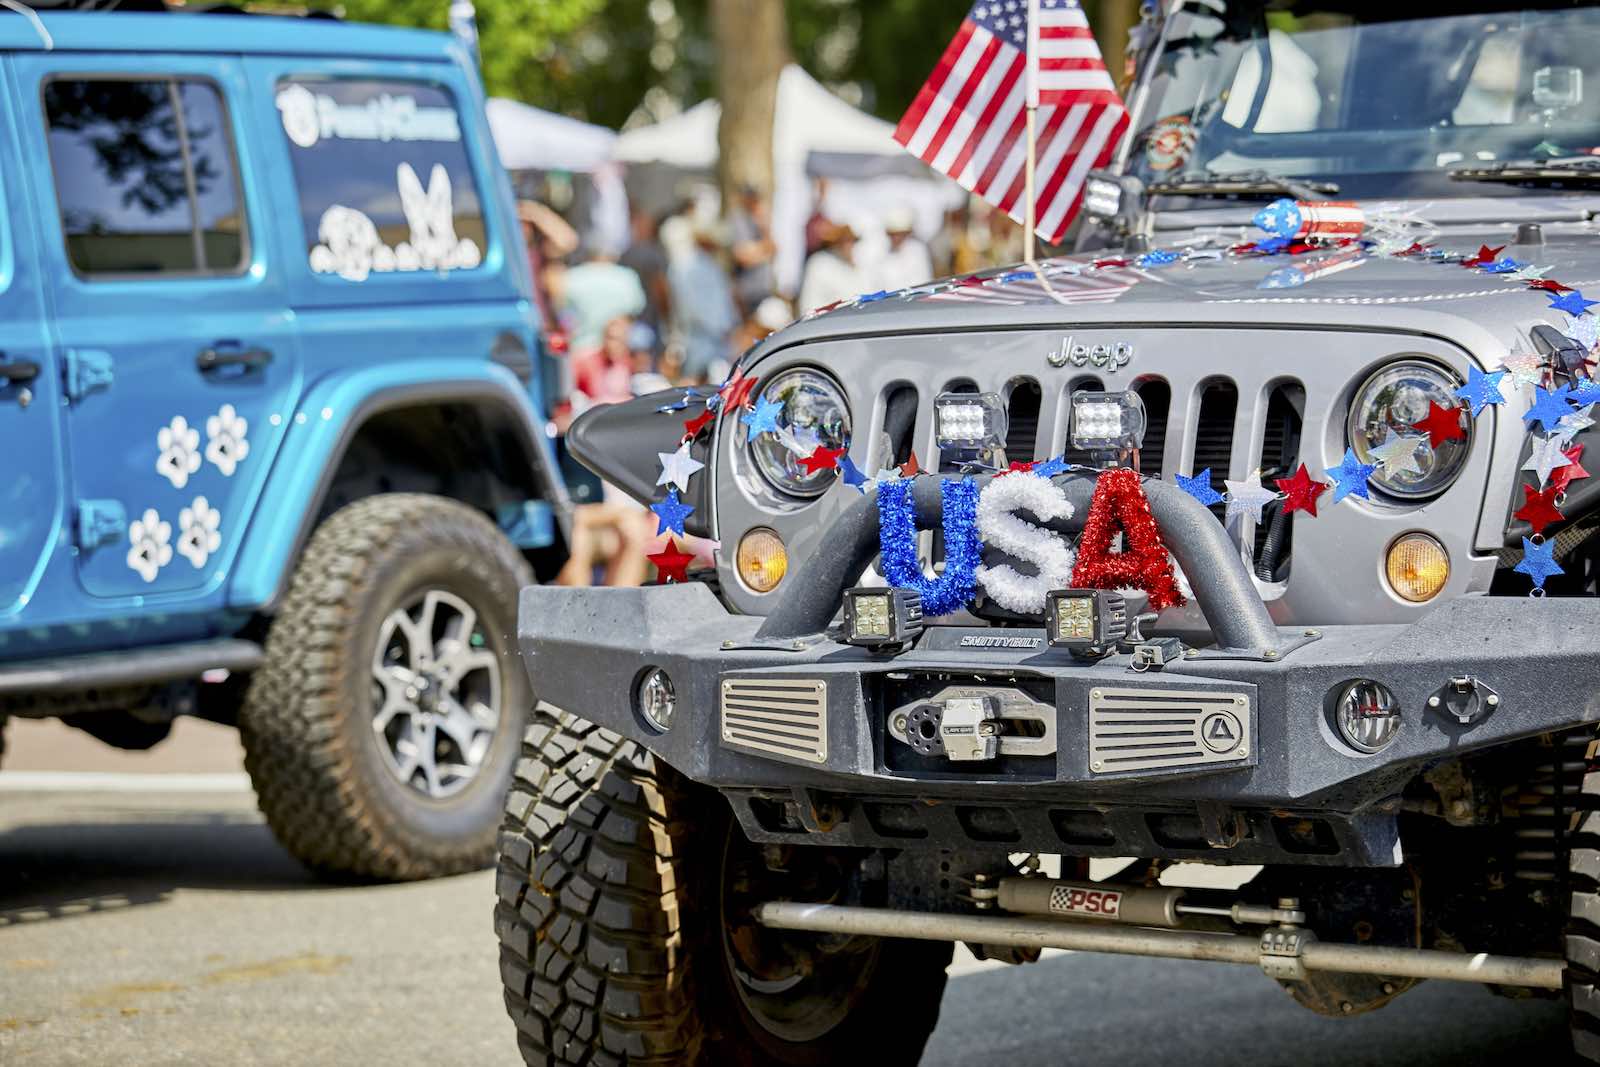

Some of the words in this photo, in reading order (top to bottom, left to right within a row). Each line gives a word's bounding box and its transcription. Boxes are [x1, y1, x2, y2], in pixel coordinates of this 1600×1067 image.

[1047, 336, 1133, 372] Jeep
[877, 468, 1187, 616] USA
[960, 635, 1042, 648] SMITTYBILT
[1069, 889, 1119, 914] PSC
